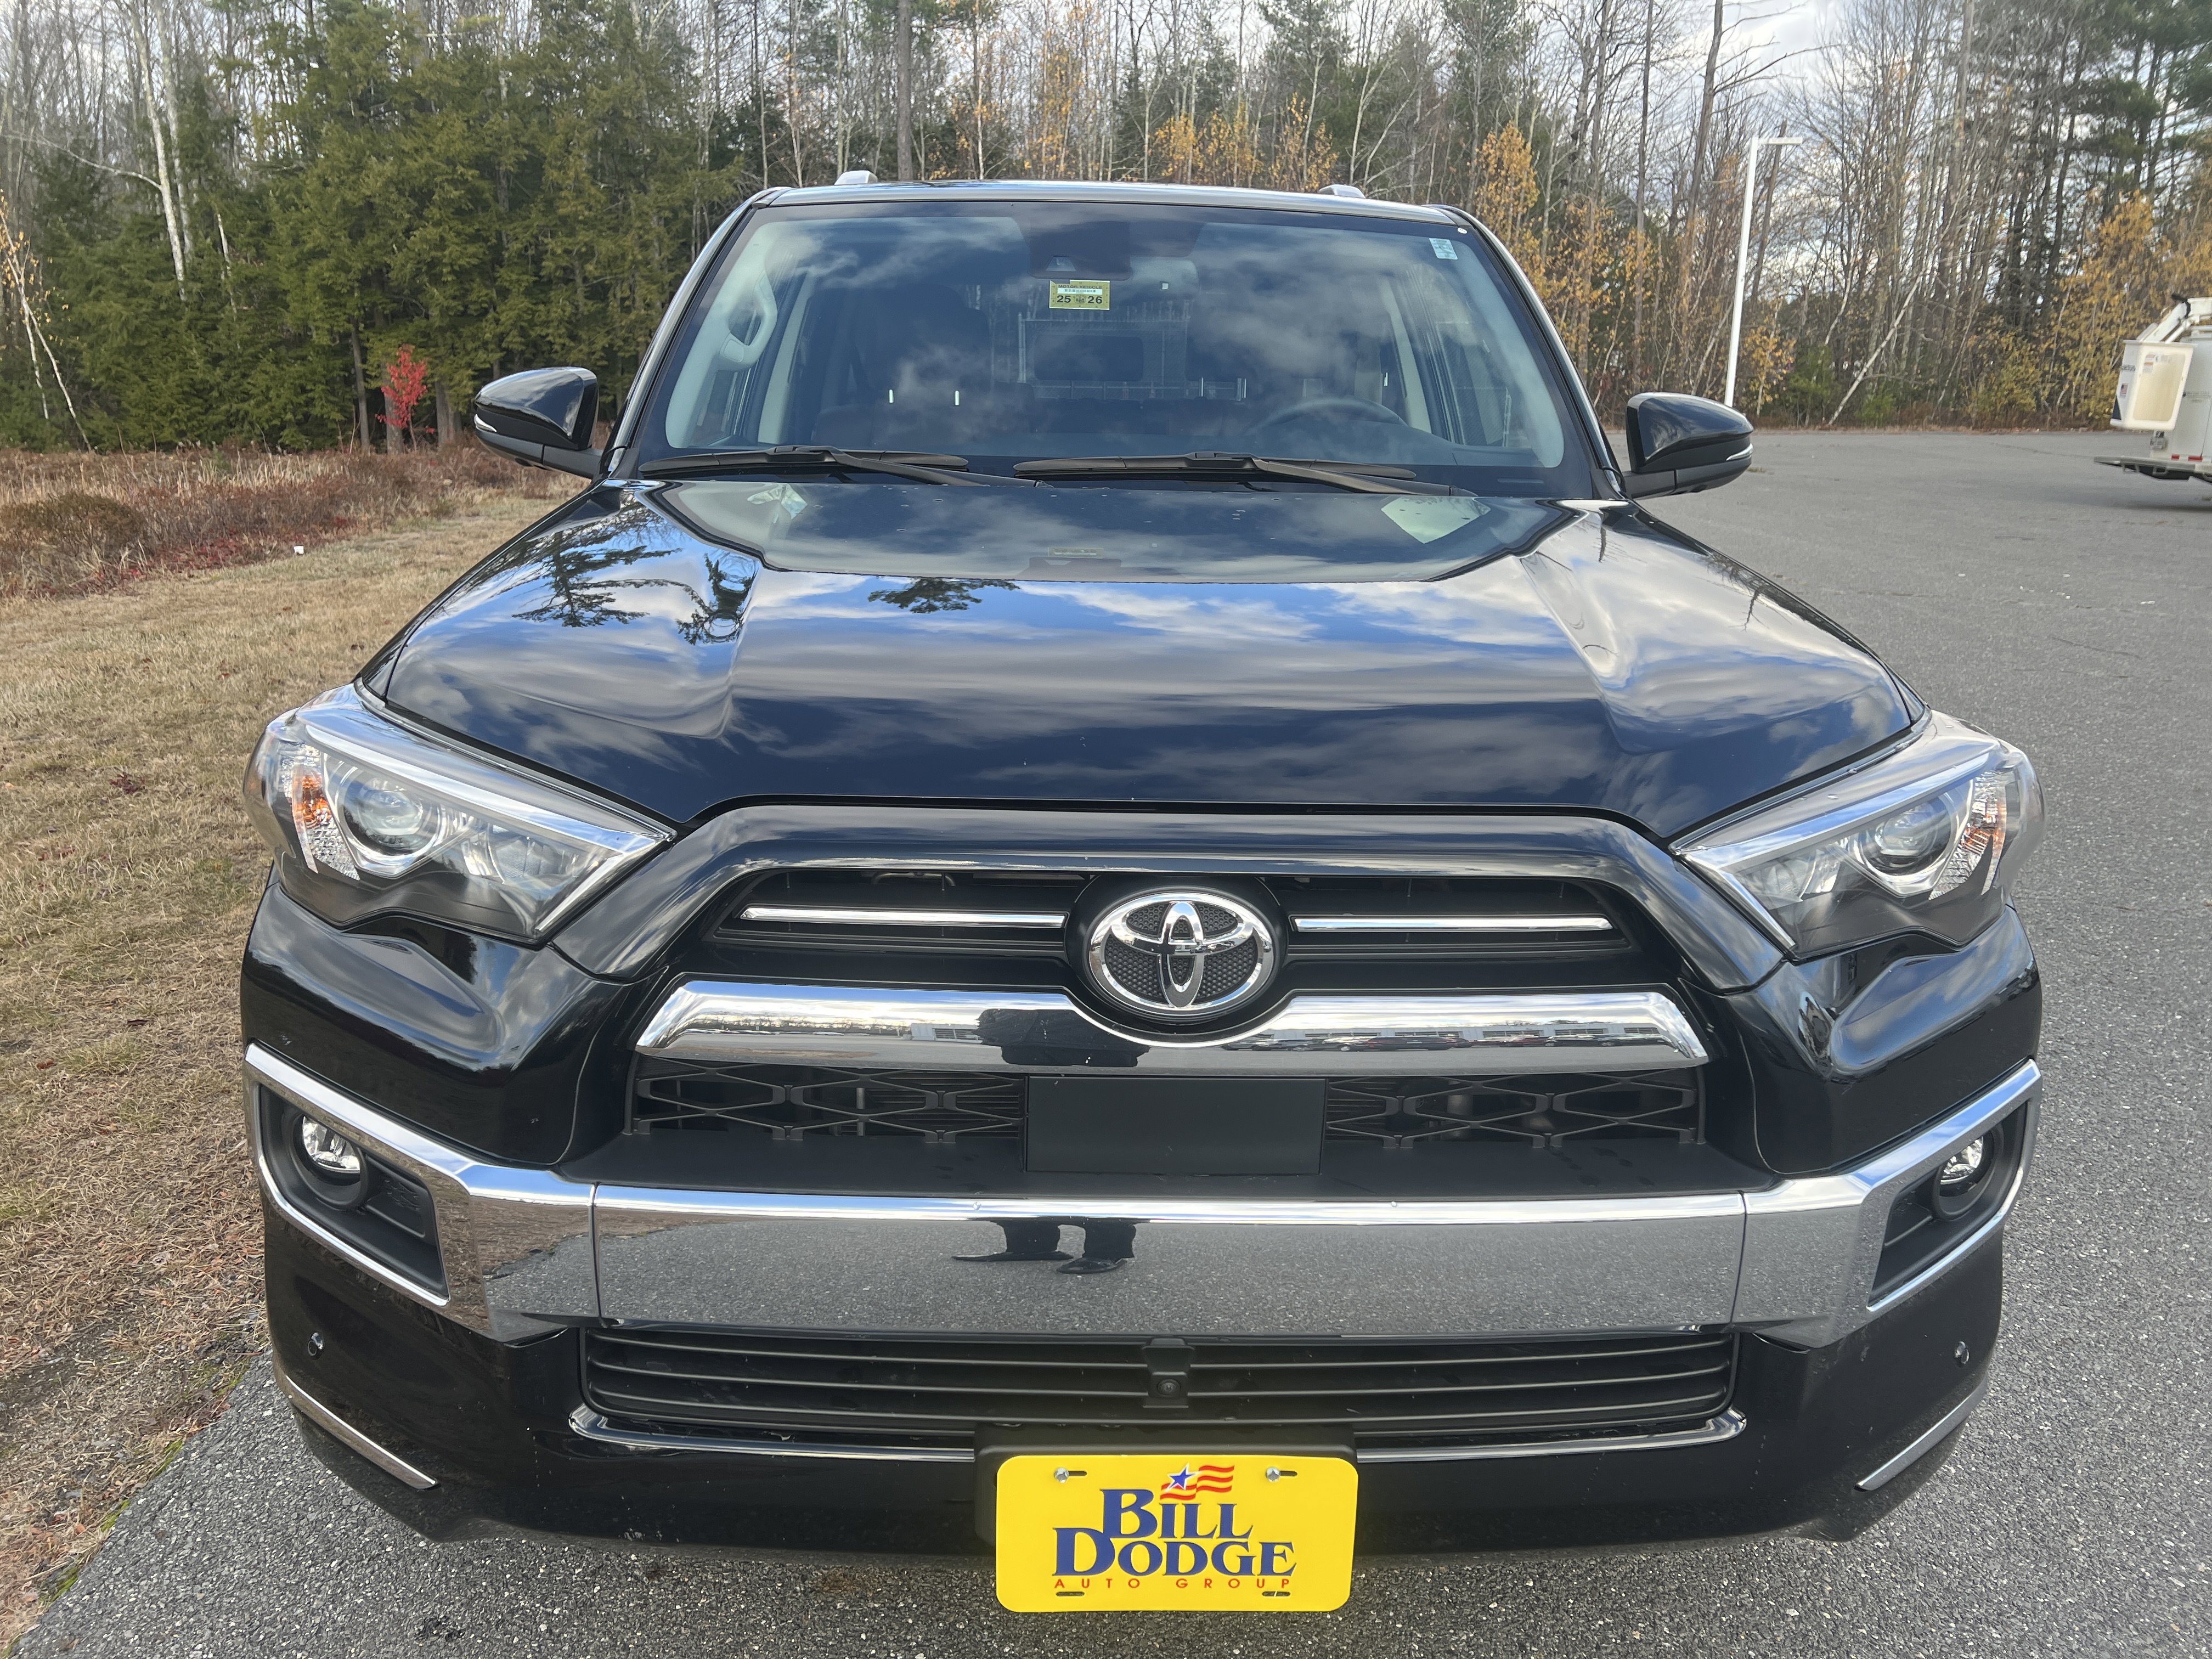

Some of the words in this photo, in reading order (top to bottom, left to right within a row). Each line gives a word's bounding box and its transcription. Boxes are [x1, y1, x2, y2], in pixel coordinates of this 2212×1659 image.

[1099, 1489, 1253, 1538] BILL
[1052, 1527, 1297, 1576] DODGE
[1054, 1578, 1140, 1588] AUTO
[1176, 1578, 1289, 1588] GROUP
